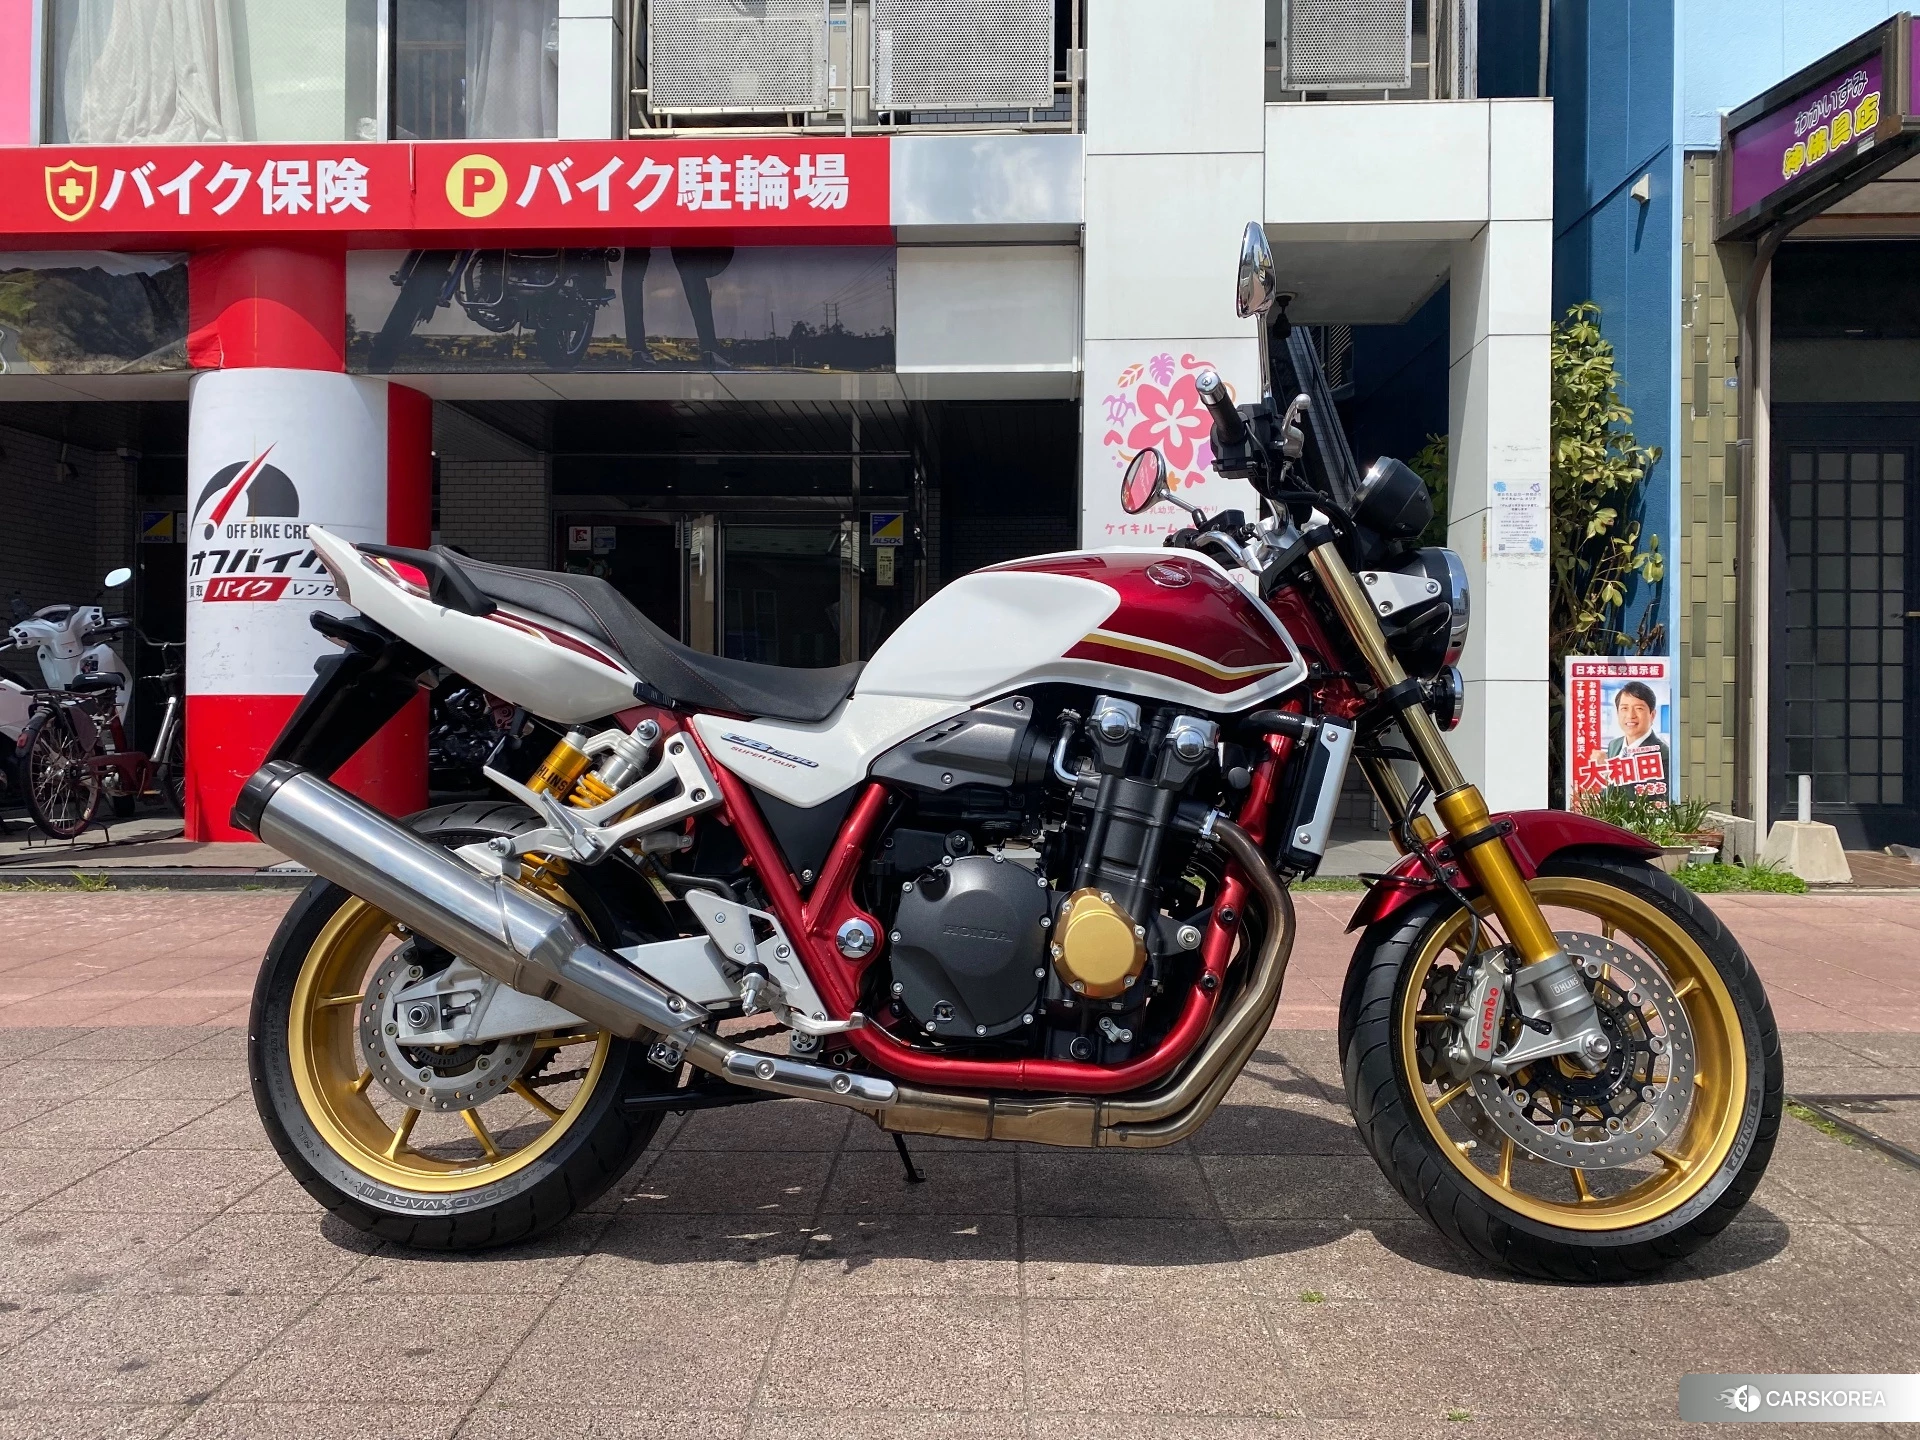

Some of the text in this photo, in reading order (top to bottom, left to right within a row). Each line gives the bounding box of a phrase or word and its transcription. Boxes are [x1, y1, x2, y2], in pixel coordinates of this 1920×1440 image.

[100, 157, 372, 216] バイク保険
[462, 167, 495, 207] P
[515, 153, 850, 212] バイク駐輪場
[226, 523, 324, 540] OFF BIKE CRE
[213, 579, 273, 598] バイク
[1576, 665, 1660, 676] 日本共産党掲示板
[1576, 681, 1586, 759] 子育てしやすい横浜へ
[730, 746, 797, 769] SUPER FOUR
[1578, 752, 1665, 791] 大和田
[535, 764, 568, 791] HLINS
[942, 924, 1014, 943] HONDA
[1477, 986, 1500, 1051] brembo
[1732, 1103, 1758, 1168] DUNLOP
